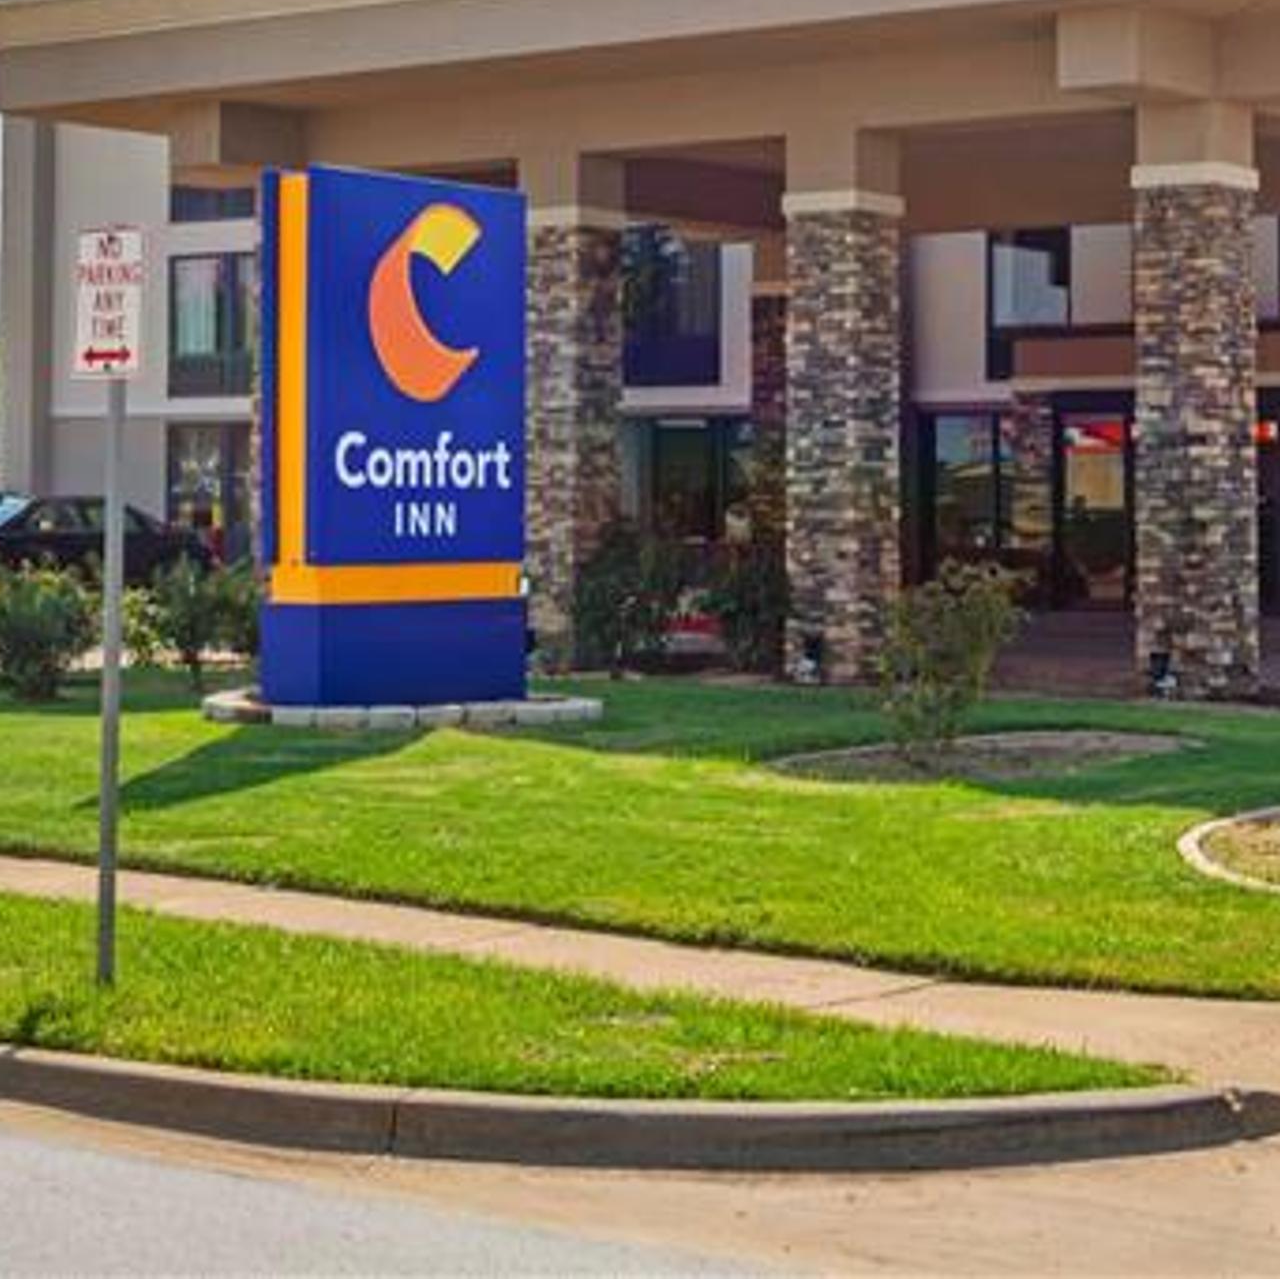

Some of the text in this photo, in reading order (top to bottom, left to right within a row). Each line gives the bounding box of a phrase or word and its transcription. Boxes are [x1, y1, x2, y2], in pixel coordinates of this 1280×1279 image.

[97, 237, 123, 259] NO
[75, 263, 144, 285] PARKING
[93, 290, 125, 312] ANY
[335, 431, 511, 489] Comfort
[395, 502, 457, 537] INN
